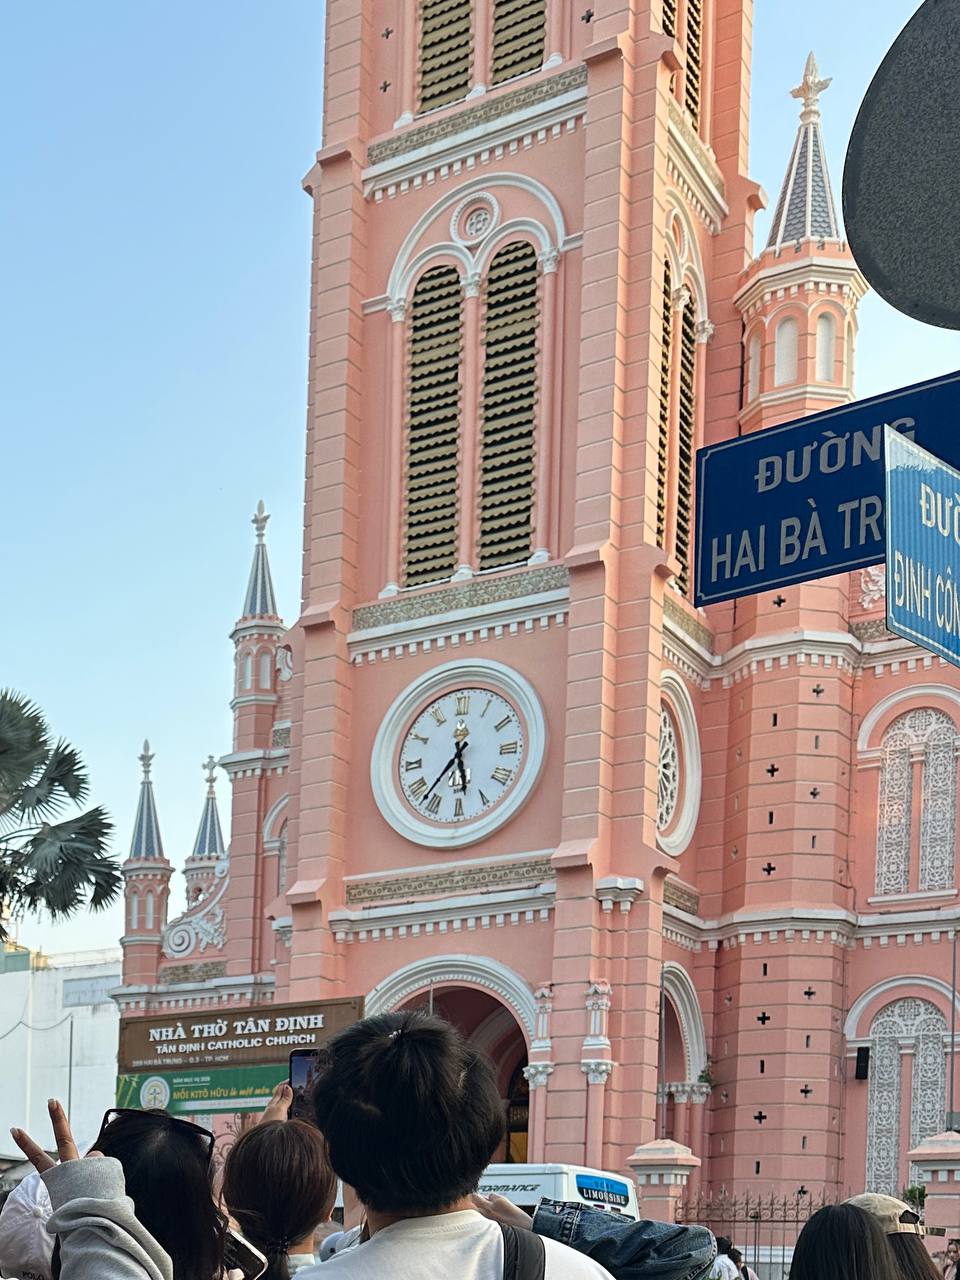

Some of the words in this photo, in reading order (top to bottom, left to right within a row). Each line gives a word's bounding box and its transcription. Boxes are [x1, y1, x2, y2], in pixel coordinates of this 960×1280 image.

[711, 524, 765, 582] HAI
[779, 499, 827, 566] BÀ
[838, 495, 885, 549] TR
[894, 549, 931, 622] ĐINH
[148, 1022, 187, 1041] NHÀ
[191, 1019, 228, 1038] THỜ
[233, 1017, 271, 1035] TÂN
[275, 1014, 324, 1033] ĐỊNH
[156, 1043, 177, 1054] TÂN
[178, 1041, 205, 1054] ĐỊNH
[207, 1037, 262, 1051] CATHOLIC
[266, 1033, 316, 1047] CHURCH
[583, 1188, 626, 1205] LIMOUSINE
